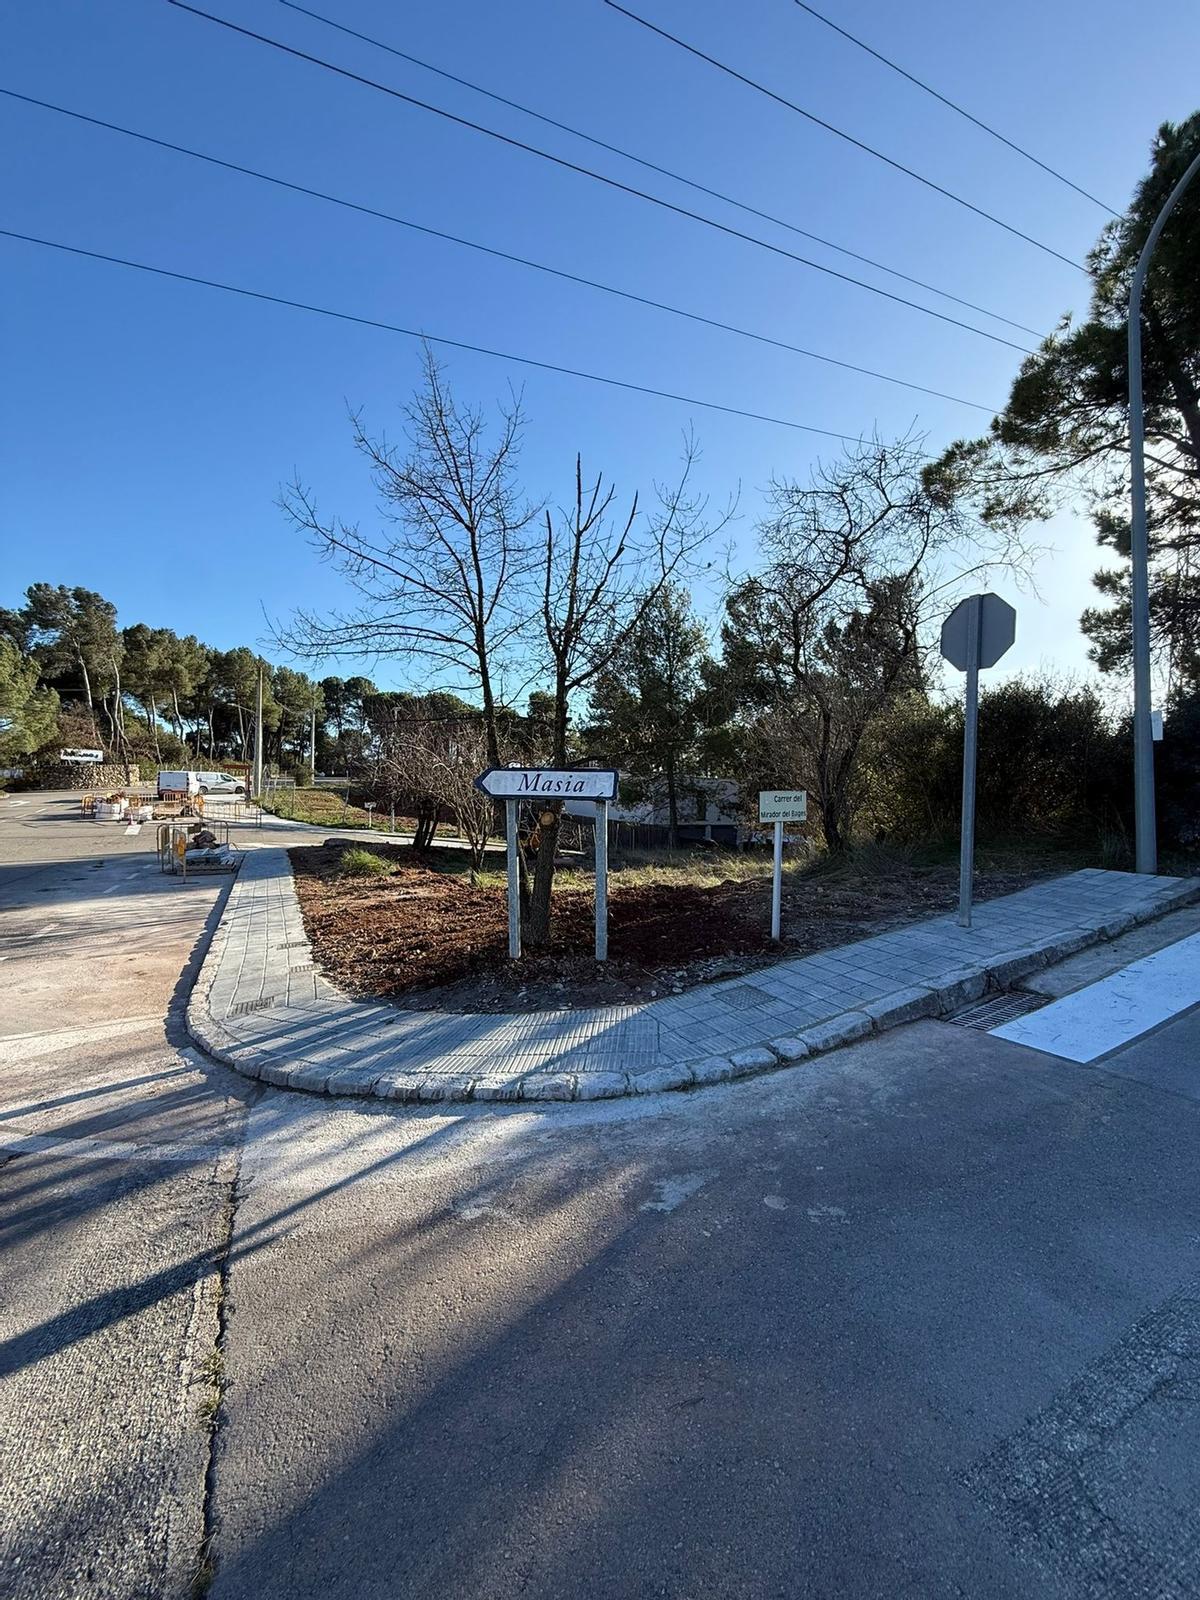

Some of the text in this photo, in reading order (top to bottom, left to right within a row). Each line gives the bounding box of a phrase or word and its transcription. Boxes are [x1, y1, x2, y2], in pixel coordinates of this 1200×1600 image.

[517, 773, 585, 793] Masia
[774, 794, 802, 803] Carrer del
[782, 810, 790, 818] del
